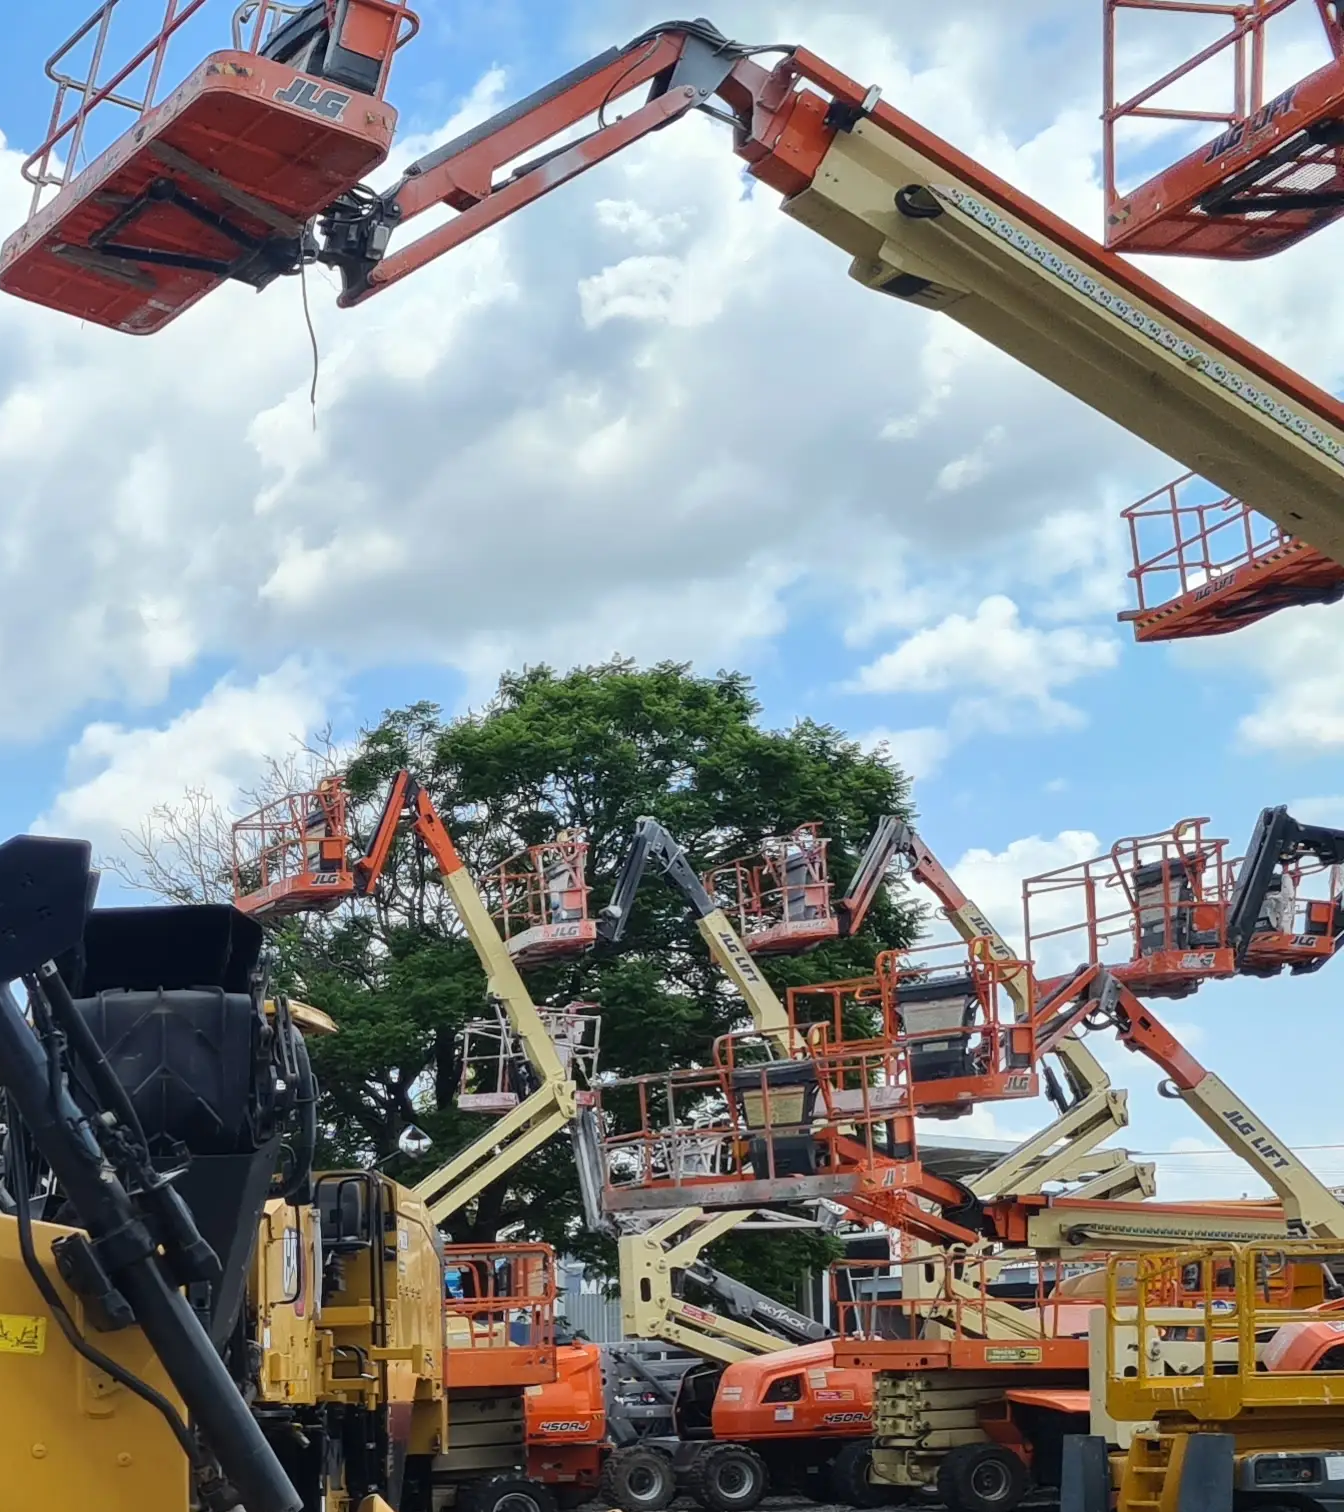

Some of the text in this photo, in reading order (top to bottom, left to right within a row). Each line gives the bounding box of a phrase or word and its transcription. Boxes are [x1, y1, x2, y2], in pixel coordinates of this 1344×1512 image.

[273, 77, 351, 120] JLG
[1204, 121, 1245, 165] JLG
[1194, 574, 1235, 602] JLG LIFT
[312, 873, 339, 885] JLG
[551, 926, 580, 937] JLG
[969, 916, 992, 936] JLG
[1290, 936, 1317, 946] JLG
[718, 931, 760, 981] JLG LIFT
[1005, 1076, 1030, 1091] JLG
[1222, 1110, 1291, 1169] JLG LIFT
[756, 1301, 808, 1331] SKYJACK
[540, 1421, 590, 1432] 450AJ
[823, 1412, 873, 1424] 450AJ
